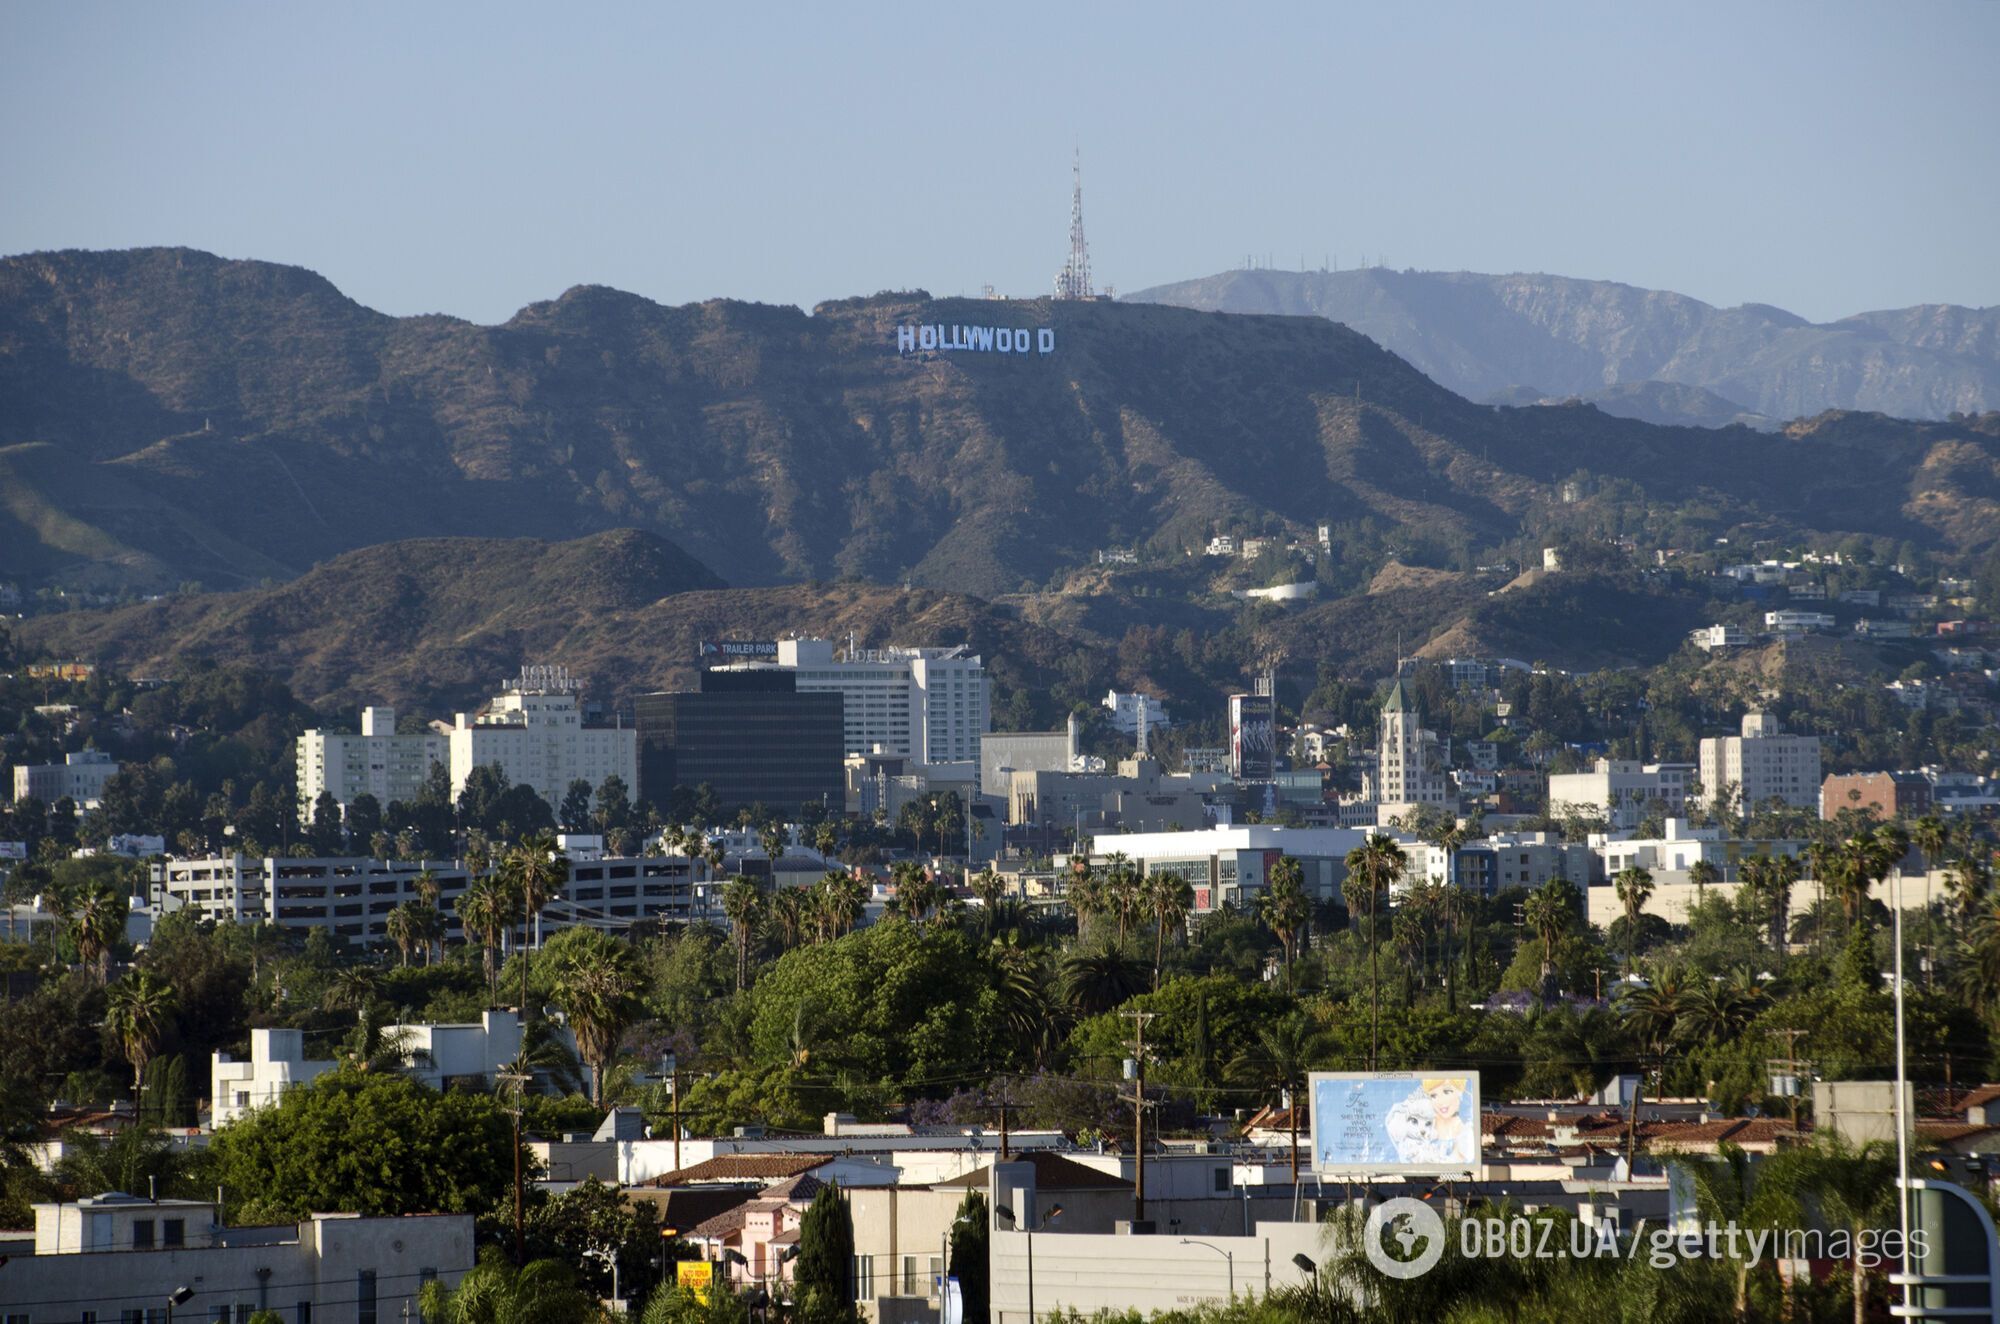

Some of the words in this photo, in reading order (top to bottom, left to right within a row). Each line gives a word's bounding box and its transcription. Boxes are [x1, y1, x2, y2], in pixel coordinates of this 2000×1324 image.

[897, 324, 1055, 355] HOLLYWOOD
[722, 643, 754, 655] TRAILER
[756, 643, 777, 655] PARK
